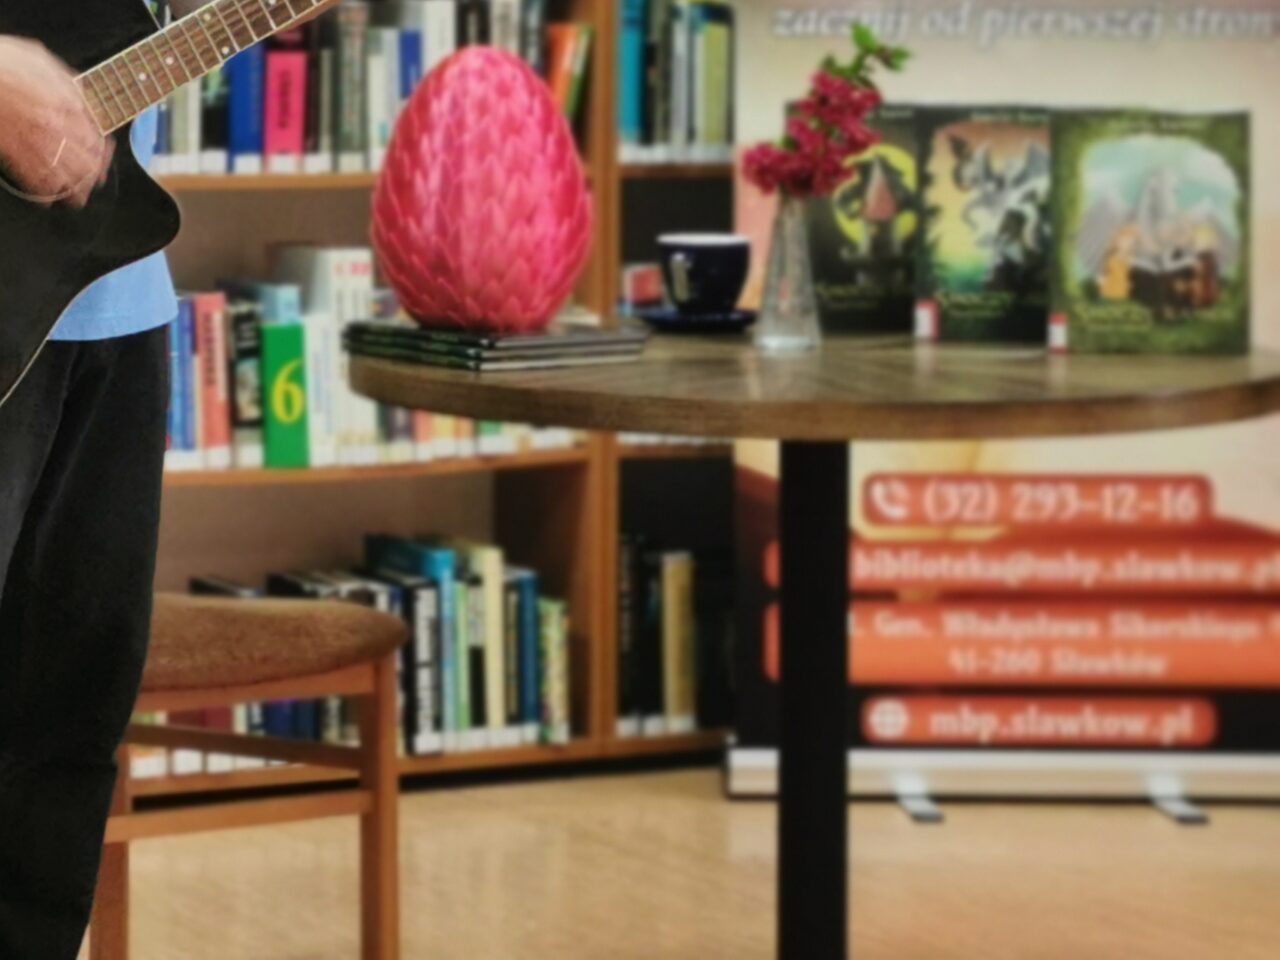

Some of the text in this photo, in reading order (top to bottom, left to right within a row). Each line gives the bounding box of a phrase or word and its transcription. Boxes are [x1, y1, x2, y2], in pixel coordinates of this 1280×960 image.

[919, 1, 969, 36] od
[977, 0, 1162, 46] pierwszej
[1177, 4, 1280, 37] stron
[270, 356, 305, 424] 6
[923, 481, 1199, 523] (32) 293-12-16
[930, 702, 1195, 745] mbp.slawkow.pl
